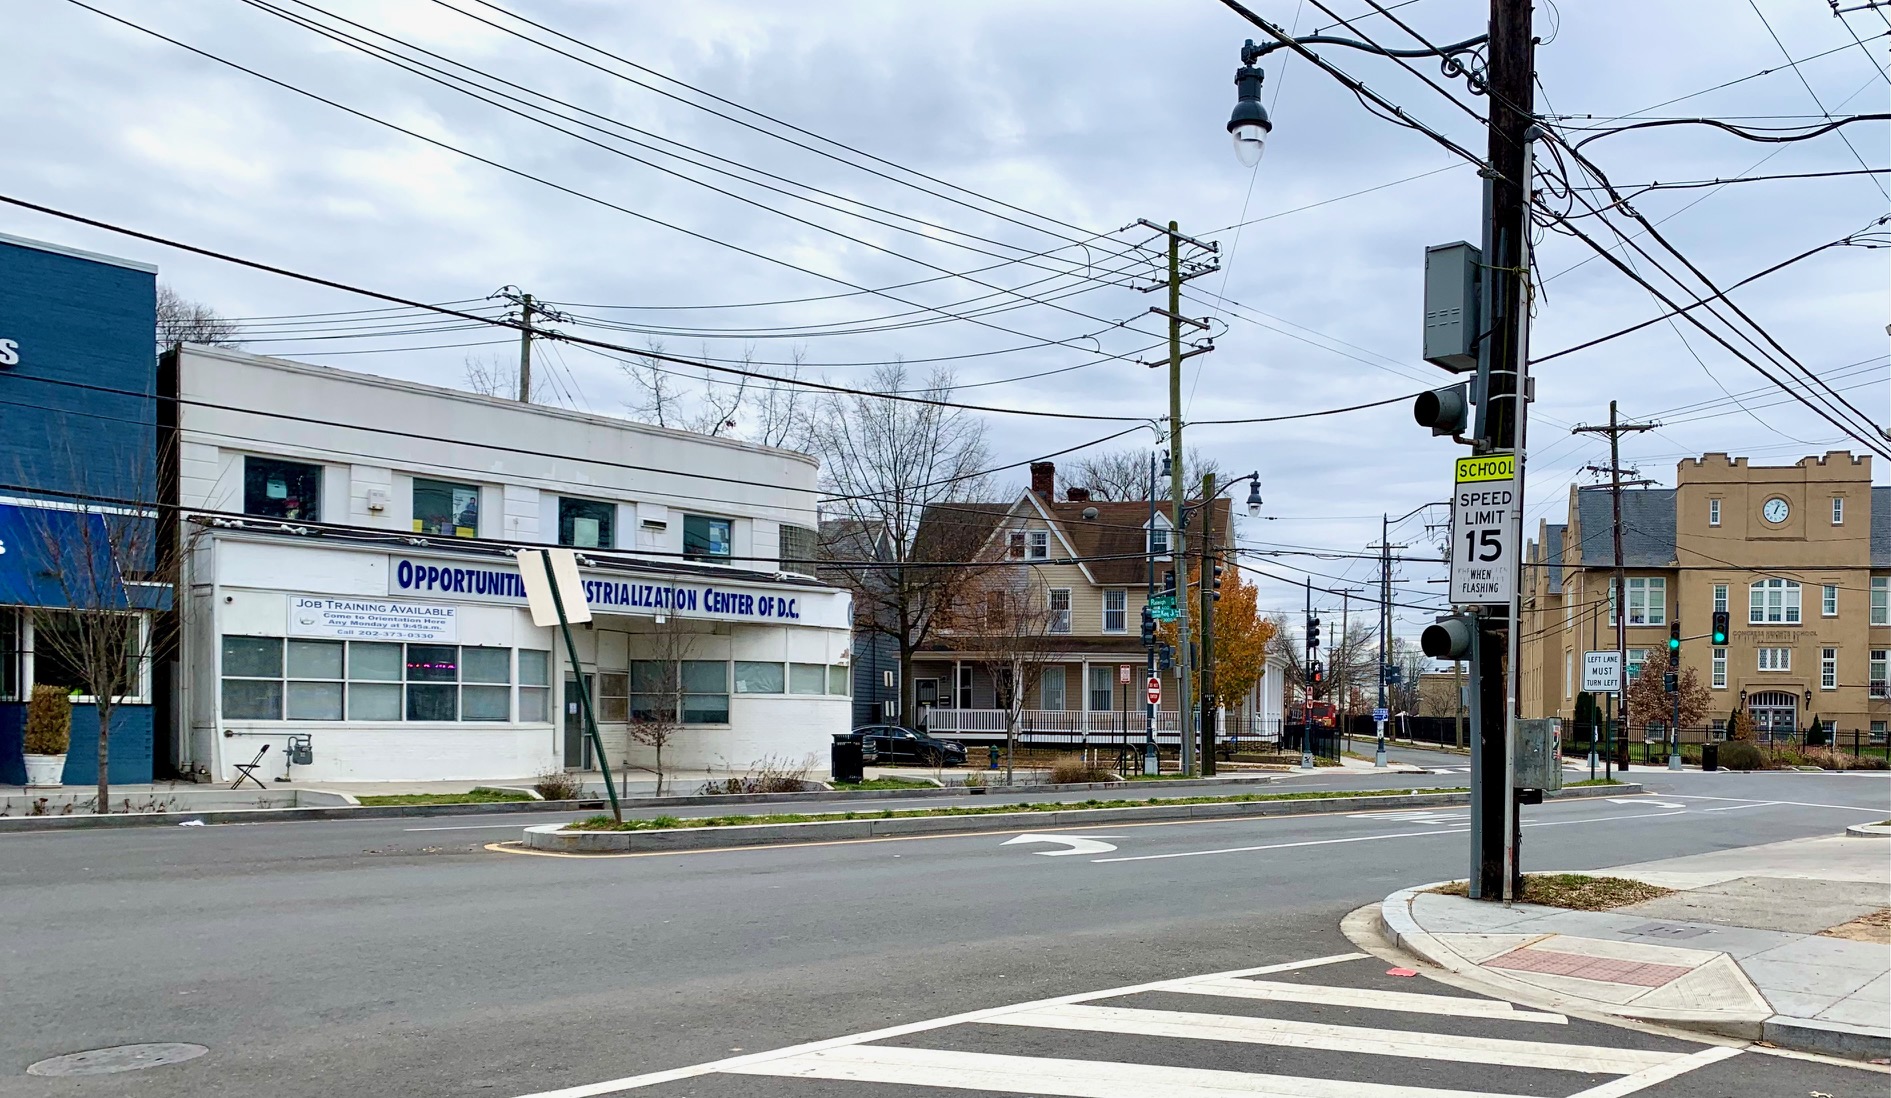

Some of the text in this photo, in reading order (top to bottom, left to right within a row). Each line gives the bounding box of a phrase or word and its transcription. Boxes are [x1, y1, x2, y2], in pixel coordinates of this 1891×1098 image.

[1459, 461, 1514, 478] SCHOOL
[1460, 491, 1512, 507] SPEED
[1465, 510, 1505, 525] LIMIT
[1466, 529, 1502, 562] 15
[1470, 569, 1492, 580] WHEN
[397, 559, 800, 619] OPPORTUNITI STRIALIZATION CENTER OF D.C.
[1462, 582, 1499, 593] FLASHING
[296, 599, 454, 617] JOB TRAINING AVAILABLE
[350, 620, 388, 629] Monday
[368, 615, 421, 623] Orientation
[358, 630, 434, 639] 202-373-0330
[1587, 655, 1618, 663] LEFT LANE
[1592, 666, 1613, 675] MUST
[1587, 679, 1618, 687] TURN LEFT
